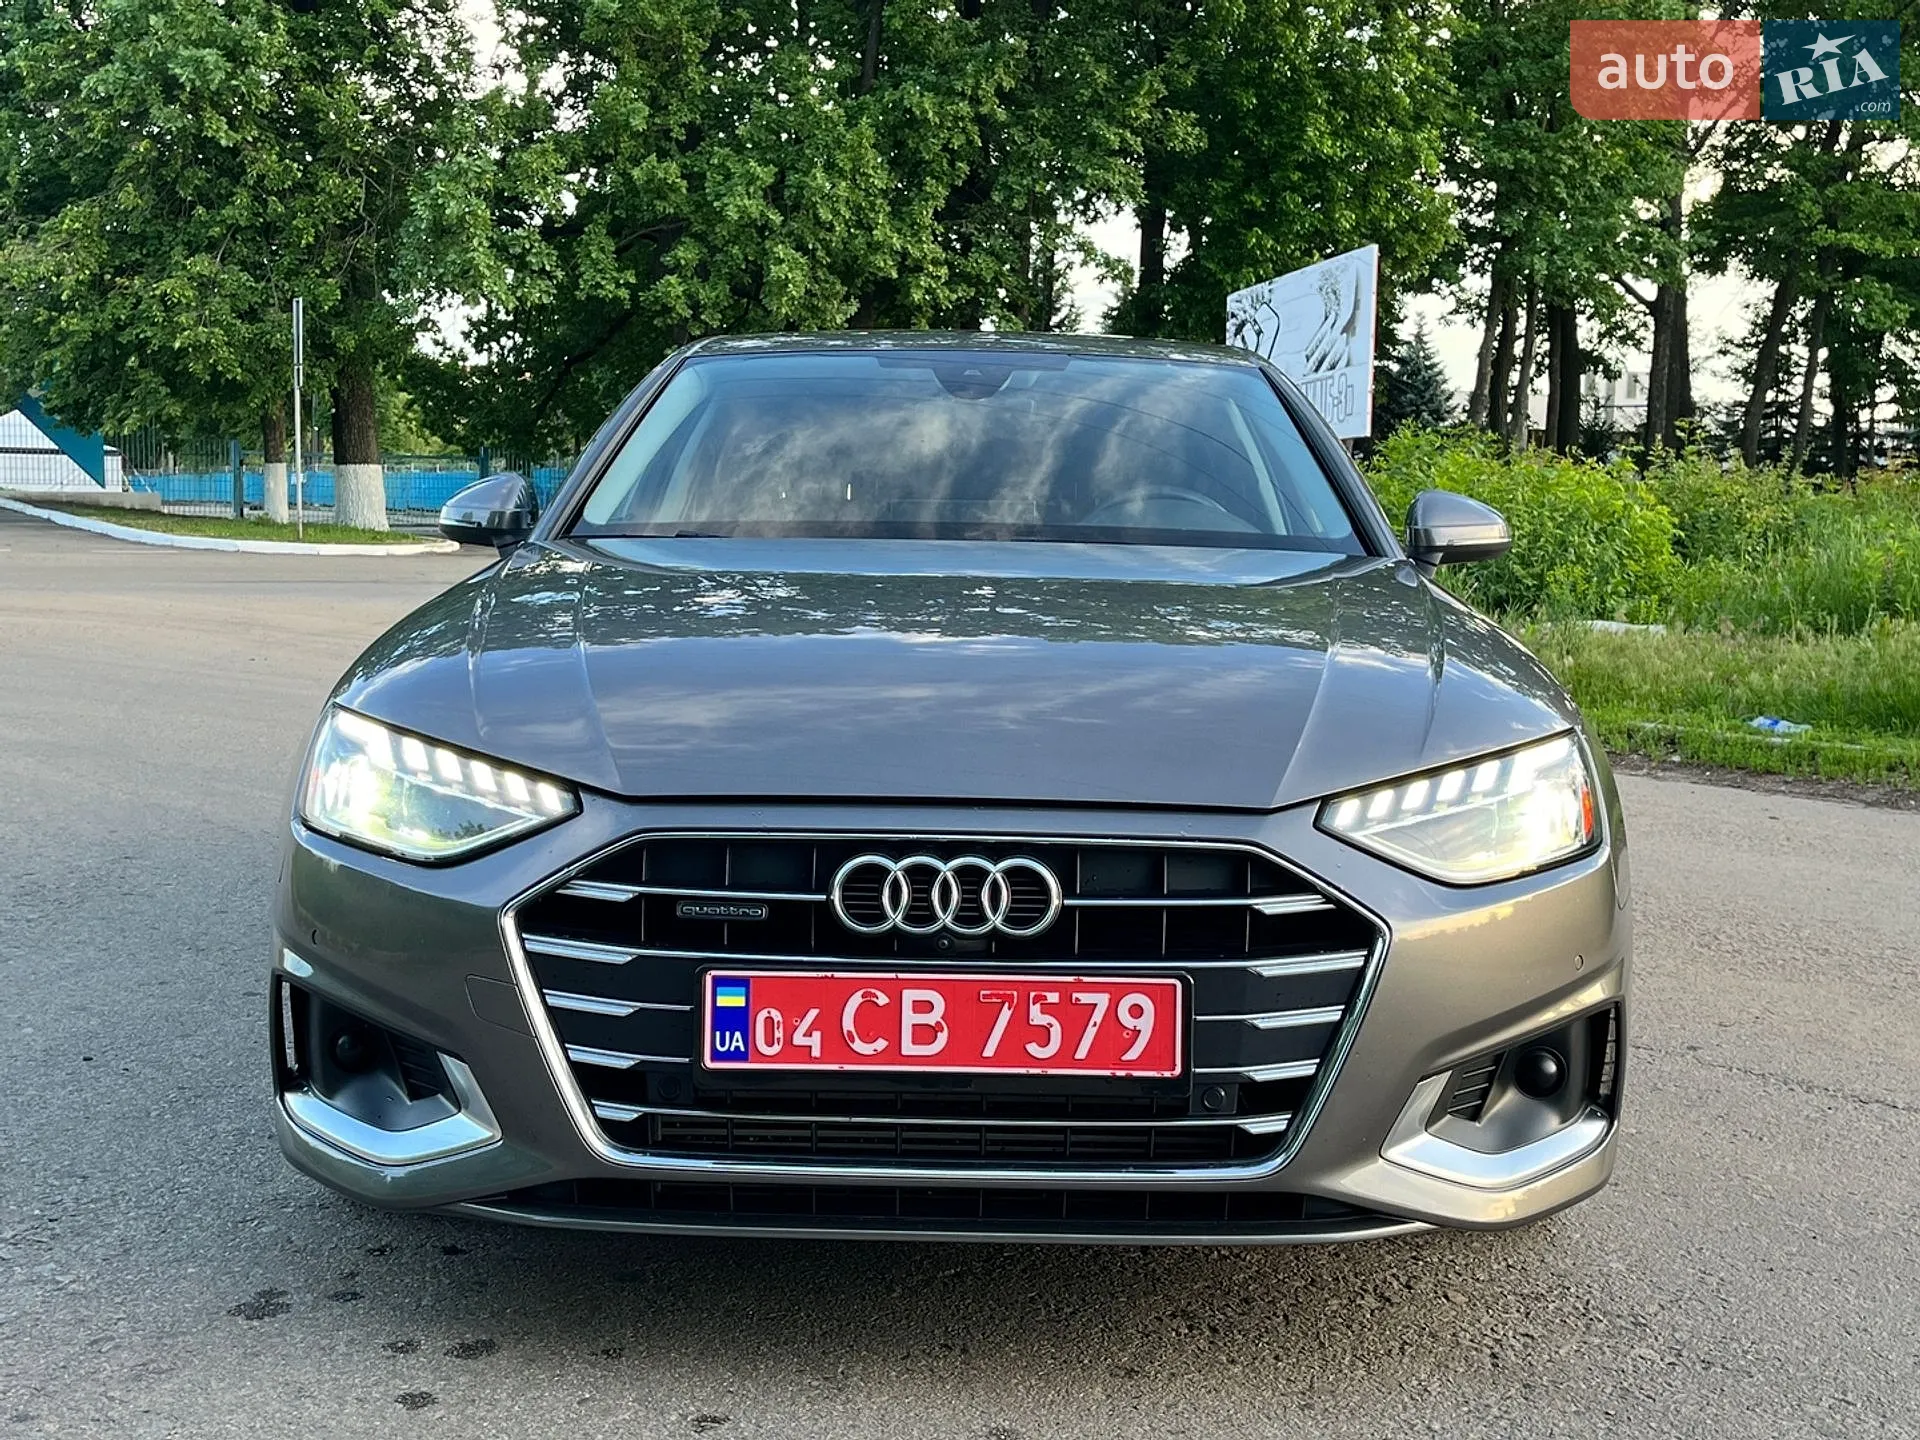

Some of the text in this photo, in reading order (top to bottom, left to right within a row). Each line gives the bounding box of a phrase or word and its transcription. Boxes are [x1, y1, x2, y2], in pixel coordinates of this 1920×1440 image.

[682, 906, 762, 916] quattro
[754, 987, 1156, 1061] 04 CB 7579
[715, 1030, 745, 1052] UA
